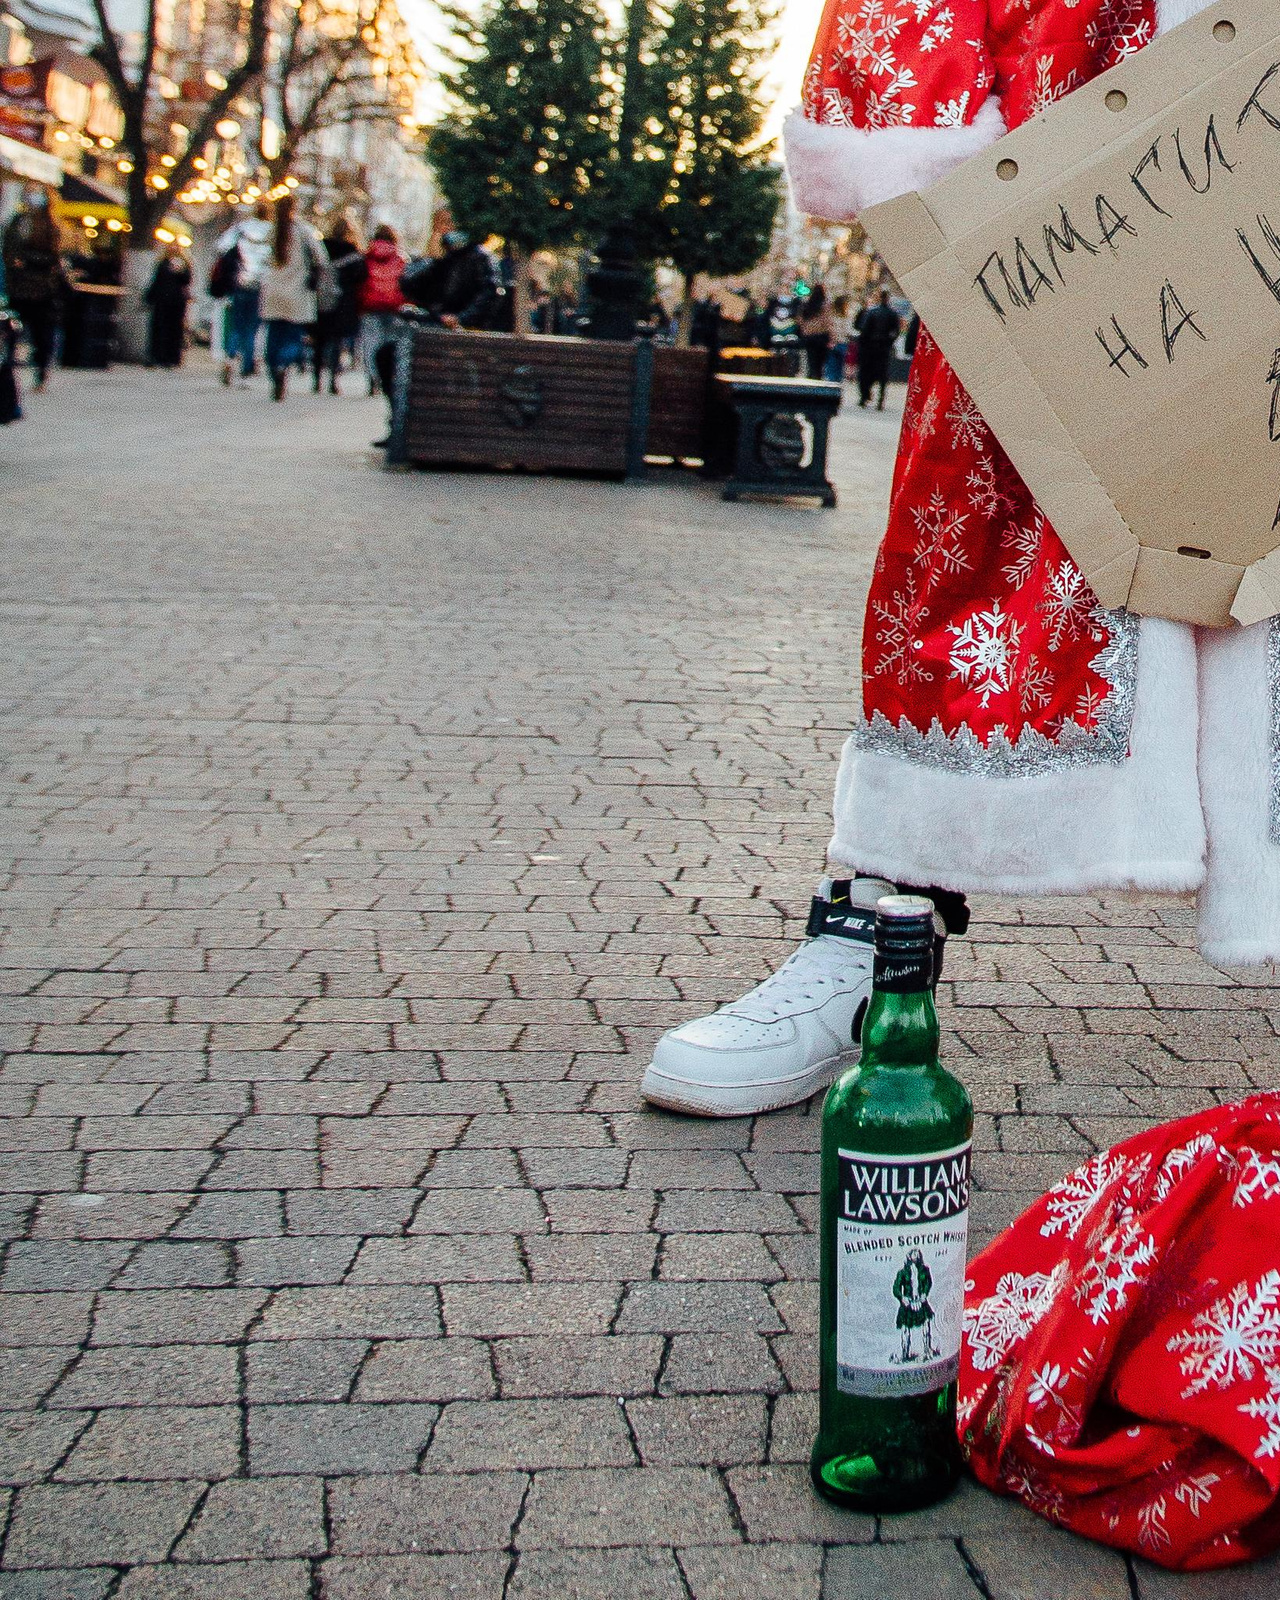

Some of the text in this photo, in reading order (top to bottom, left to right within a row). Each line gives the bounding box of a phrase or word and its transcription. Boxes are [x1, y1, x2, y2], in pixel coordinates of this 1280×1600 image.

[1093, 277, 1210, 378] НА
[843, 916, 867, 930] NIKE
[851, 1154, 967, 1194] WILLIAM
[844, 1179, 970, 1220] LAWSON'S
[844, 1237, 893, 1254] BLENDED
[898, 1231, 940, 1247] SCOTCH
